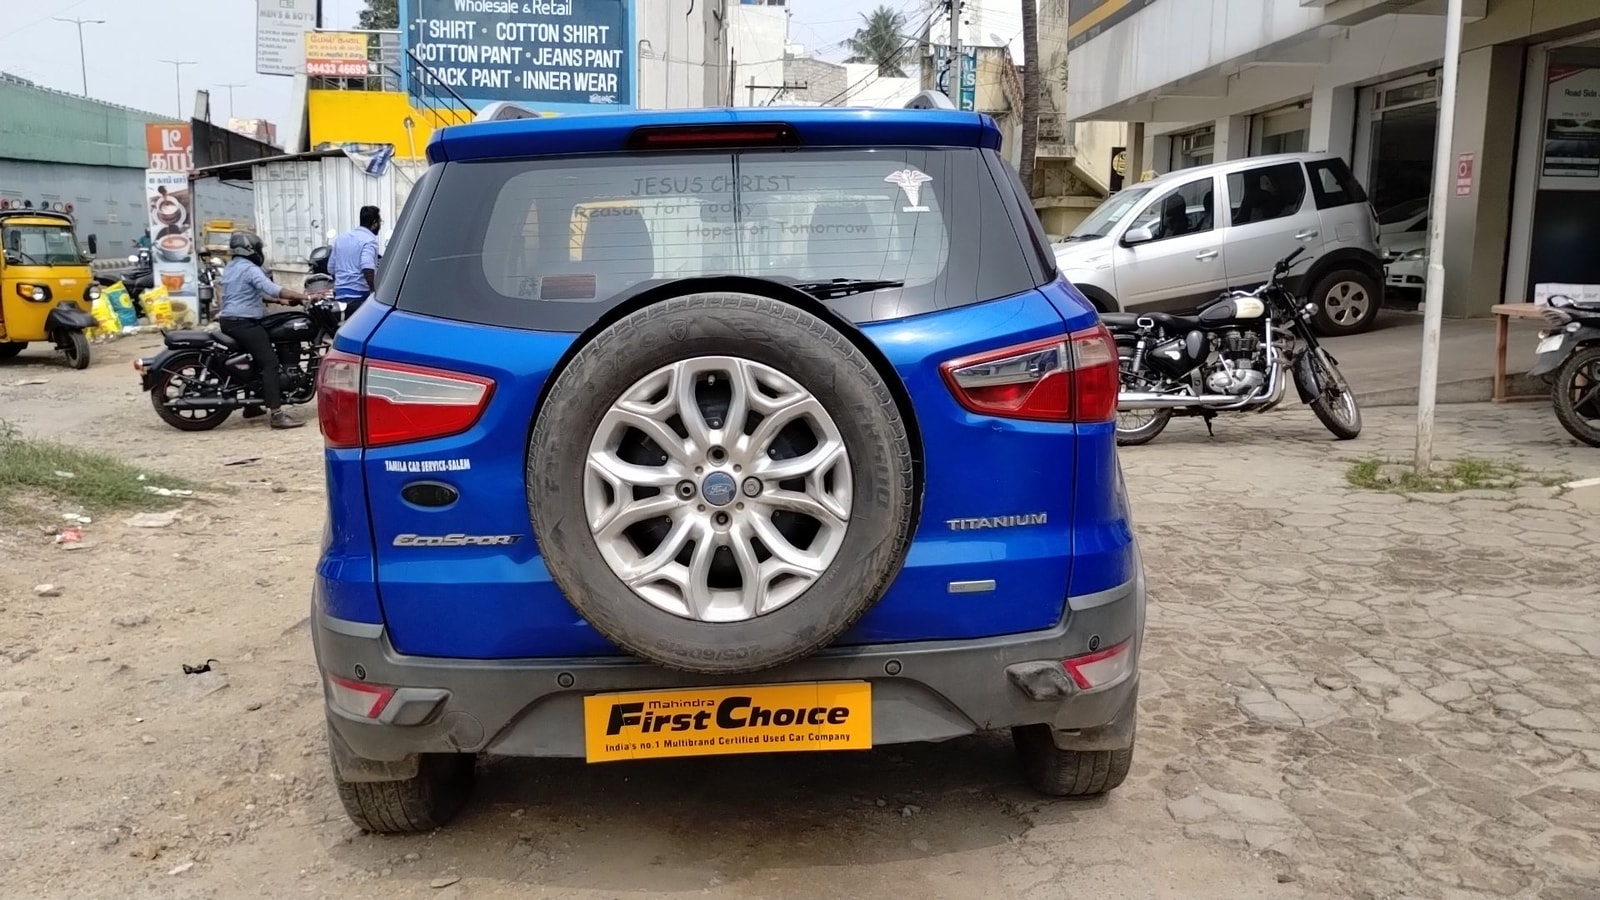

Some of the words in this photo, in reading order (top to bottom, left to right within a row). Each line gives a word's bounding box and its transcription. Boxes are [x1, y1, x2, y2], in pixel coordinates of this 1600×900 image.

[454, 0, 519, 14] Wholesale
[522, 5, 532, 14] &
[532, 0, 572, 16] Retail
[429, 20, 476, 40] SHIRT
[496, 22, 559, 42] COTTON
[563, 24, 609, 44] SHIRT
[416, 43, 477, 62] COTTON
[481, 45, 523, 64] PANT
[532, 48, 582, 66] JEANS
[585, 49, 623, 68] PANT
[307, 63, 336, 73] 94433
[338, 64, 367, 74] 46693
[416, 66, 467, 87] TRACK
[471, 69, 512, 88] PANT
[523, 71, 571, 90] INNER
[574, 72, 618, 92] WEAR
[631, 177, 703, 195] JESUS
[711, 175, 795, 193] CHRIST
[575, 205, 645, 219] Reason
[654, 202, 682, 214] for
[686, 222, 732, 238] Hope
[780, 221, 868, 235] Tomorrow
[408, 461, 421, 472] CAR
[946, 511, 1047, 531] TITANIUM
[648, 698, 715, 709] Mahindra
[606, 701, 713, 736] First
[715, 696, 850, 730] Choice
[605, 742, 636, 752] India's
[640, 741, 660, 749] no.1
[663, 737, 715, 747] Multibrand
[718, 735, 760, 745] Certified
[763, 733, 785, 743] Used
[788, 733, 805, 742] Car
[808, 732, 850, 742] Company
